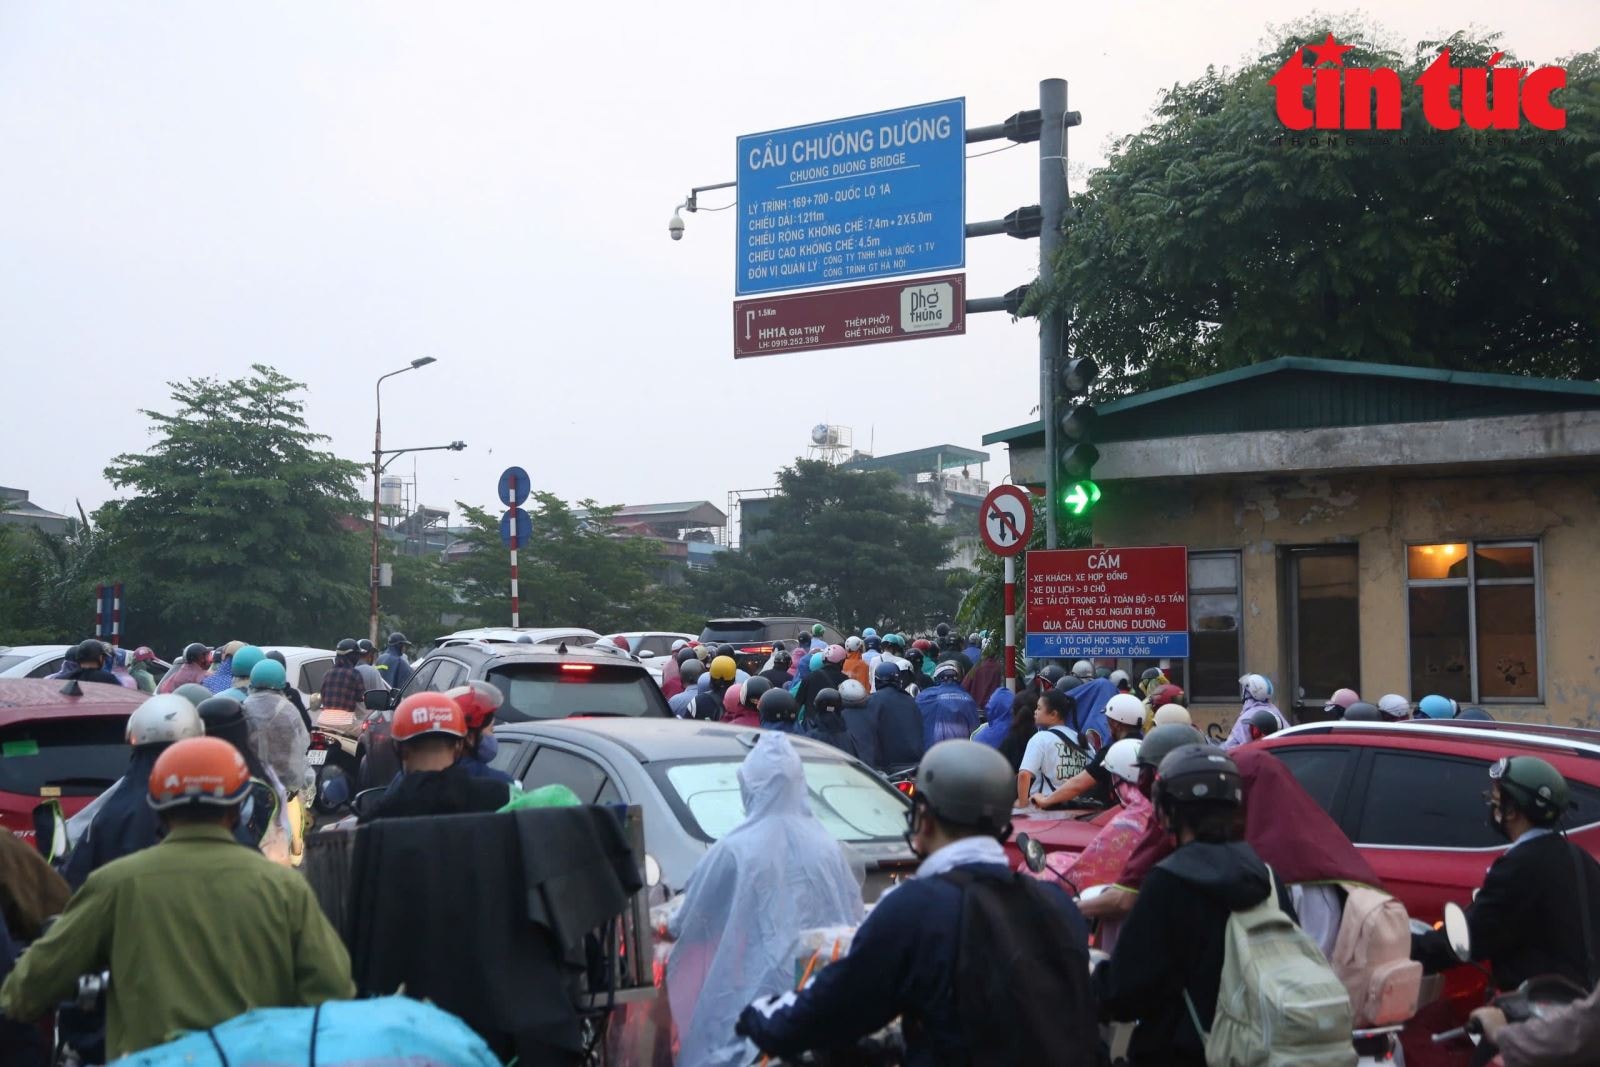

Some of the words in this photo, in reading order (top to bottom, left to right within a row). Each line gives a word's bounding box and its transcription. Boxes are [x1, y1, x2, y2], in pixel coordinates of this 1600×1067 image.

[749, 139, 787, 170] CẦU
[792, 129, 874, 163] CHƯƠNG
[879, 115, 951, 149] DƯƠNG
[833, 160, 866, 175] DUONG
[870, 152, 906, 169] BRIDGE
[834, 185, 861, 202] QUỐC
[880, 183, 891, 196] 1A
[778, 247, 796, 259] CAO
[846, 252, 855, 262] TY
[857, 250, 876, 261] TNHH
[925, 242, 935, 251] TV
[868, 262, 878, 272] GT
[880, 259, 890, 271] HÀ
[758, 326, 787, 339] HH1A
[789, 327, 803, 336] GIA
[804, 325, 826, 337] THỤY
[844, 328, 861, 338] GHÉ
[863, 325, 893, 336] THÚNG!
[758, 340, 770, 349] LH:
[771, 336, 819, 347] 0919.252.398
[1087, 549, 1120, 569] CẤM
[1076, 573, 1086, 582] XE
[1088, 573, 1104, 583] HỢP
[1106, 570, 1128, 581] ĐỒNG
[1058, 585, 1075, 595] LỊCH
[1047, 594, 1057, 605] TẢI
[1058, 594, 1069, 604] CÓ
[1071, 596, 1097, 605] TRỌNG
[1099, 593, 1110, 604] TẢI
[1113, 593, 1134, 604] TOÀN
[1135, 593, 1147, 604] BỘ
[1168, 591, 1185, 603] TẤN
[1065, 608, 1075, 616] XE
[1079, 606, 1093, 616] THÔ
[1109, 606, 1133, 616] NGƯỜI
[1144, 605, 1156, 616] BỘ
[1042, 620, 1061, 630] QUA
[1065, 617, 1084, 630] CẦU
[1087, 619, 1127, 630] CHƯƠNG
[1044, 636, 1054, 645] XE
[1056, 635, 1062, 645] Ô
[1064, 635, 1074, 645] TÔ
[1094, 636, 1110, 646] HỌC
[1135, 636, 1145, 644] XE
[1147, 635, 1169, 644] BUÝT
[1083, 645, 1103, 655] PHÉP
[1128, 645, 1151, 656] ĐỘNG
